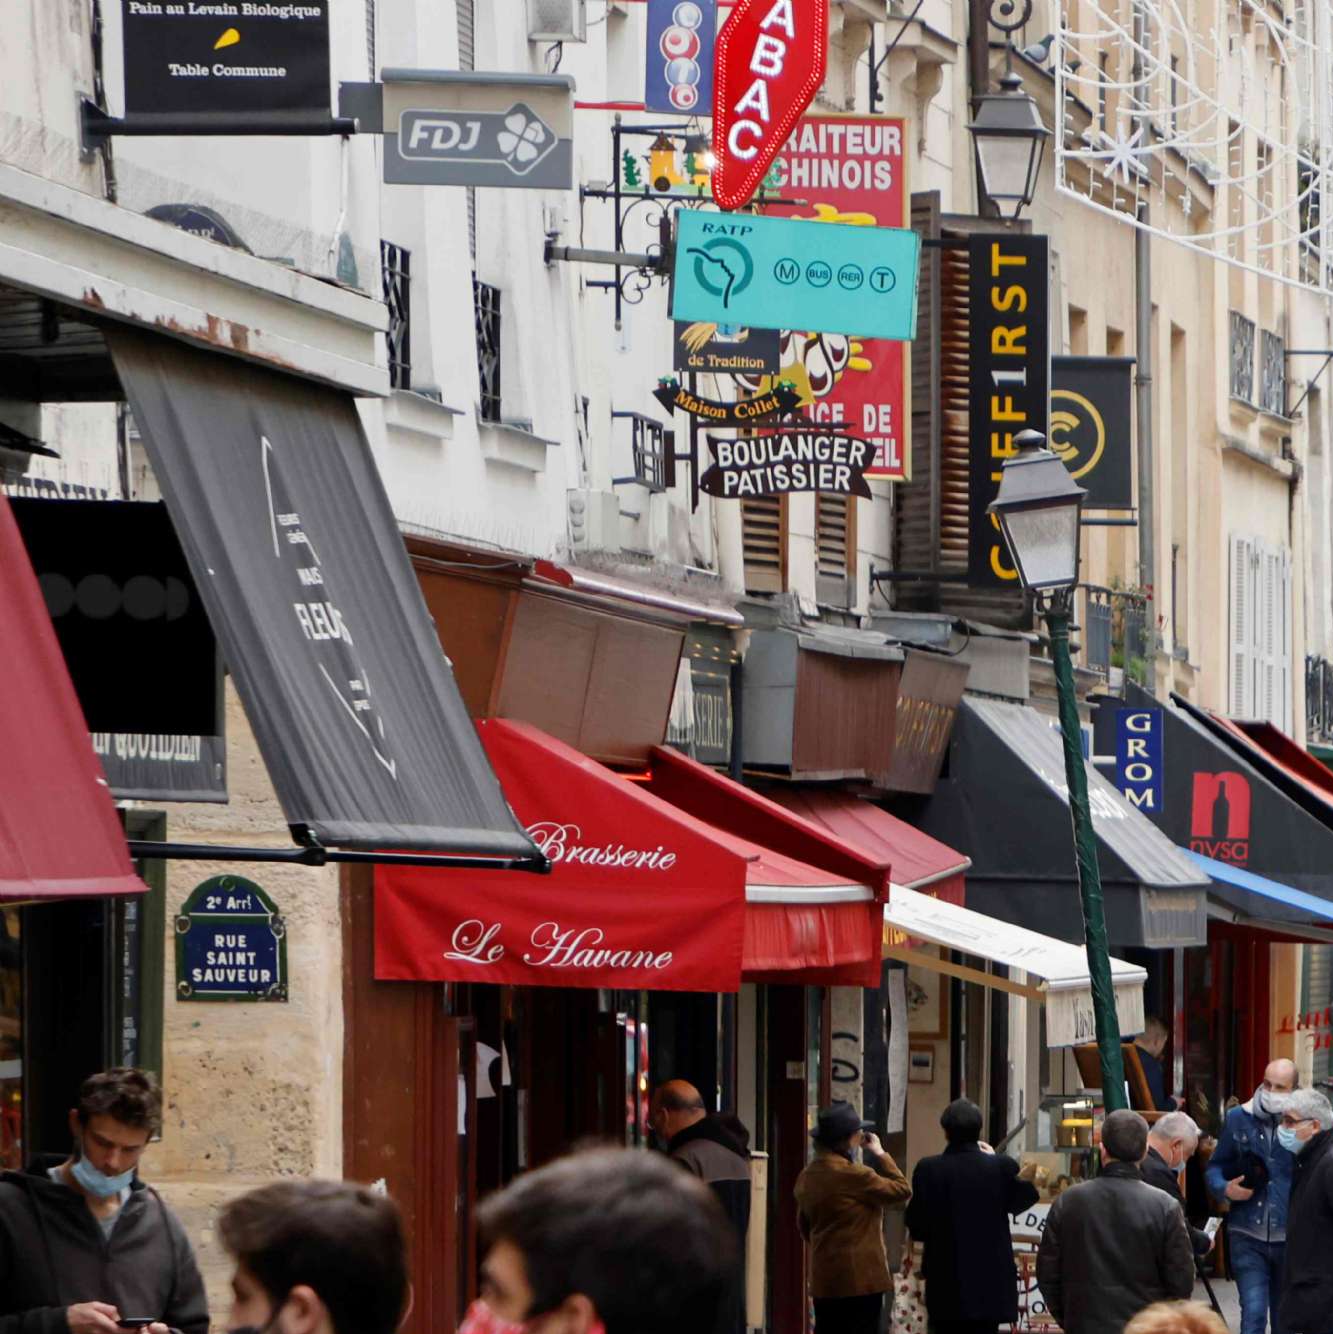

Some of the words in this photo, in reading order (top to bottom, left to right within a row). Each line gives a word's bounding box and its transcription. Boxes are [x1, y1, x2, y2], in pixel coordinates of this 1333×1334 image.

[129, 2, 162, 15] Pain
[167, 5, 185, 15] au
[189, 3, 238, 16] Levain
[242, 3, 322, 19] Biologique
[168, 64, 209, 76] Table
[213, 64, 286, 77] Commune
[409, 119, 481, 151] FDJ
[783, 124, 902, 156] RAITEUR
[774, 159, 892, 190] CHINOIS
[702, 221, 753, 237] RATP
[808, 267, 829, 280] BUS
[840, 271, 861, 283] RER
[687, 354, 704, 367] de
[707, 355, 765, 369] Tradition
[674, 390, 727, 419] Maison
[734, 396, 781, 419] Collet
[862, 403, 892, 433] DE
[717, 435, 867, 468] BOULANGER
[723, 464, 852, 497] PATISSIER
[1125, 713, 1154, 808] GROM
[525, 820, 677, 871] Brasserie
[214, 934, 248, 949] RUE
[443, 919, 505, 965] Le
[523, 921, 673, 969] Havane
[206, 951, 257, 966] SAINT
[192, 967, 272, 982] SAUVEUR
